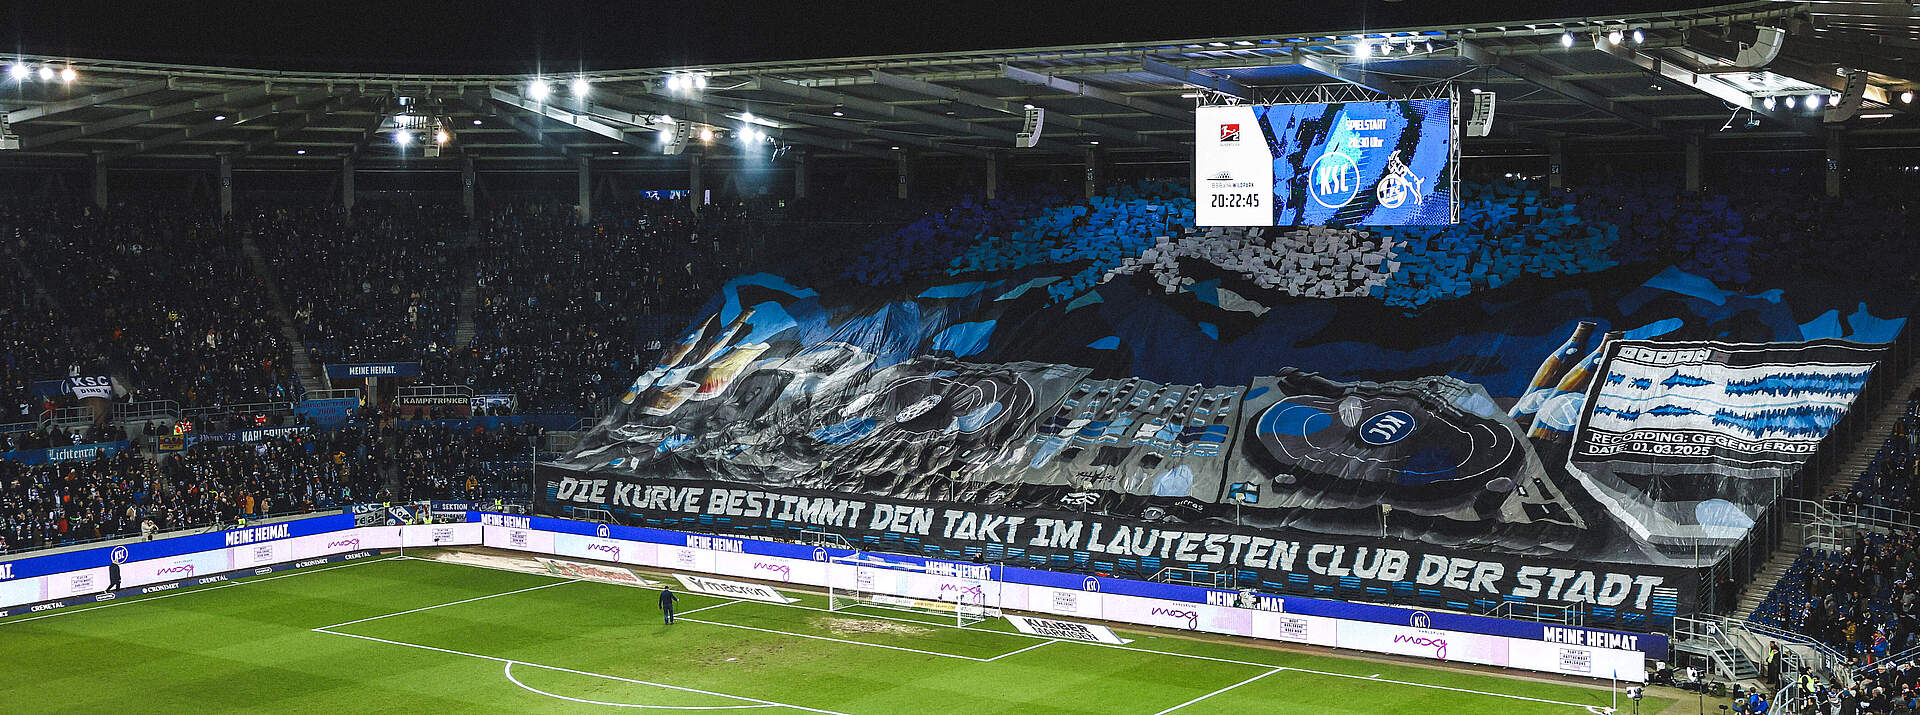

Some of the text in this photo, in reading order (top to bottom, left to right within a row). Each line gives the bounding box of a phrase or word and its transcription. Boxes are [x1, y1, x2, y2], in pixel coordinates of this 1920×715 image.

[1345, 119, 1387, 131] SPIELSTART
[1370, 137, 1385, 147] Uhr
[1320, 164, 1350, 197] KSC
[1211, 193, 1259, 208] 20:22:45
[349, 365, 396, 376] MEINE HEIMAT.
[71, 375, 109, 387] KSC
[403, 396, 468, 405] KAMPFTRINKER
[1368, 414, 1406, 440] KSC
[1588, 442, 1710, 455] DATE: 01.03.2025
[1591, 431, 1818, 453] RECORDING: GEGENGERADE
[352, 503, 381, 514] KSC
[481, 513, 504, 527] MEINE
[225, 523, 291, 547] MEINE HEIMAT.
[556, 476, 1664, 610] DIE KURVE BESTIMMT DEN TAKT IM LAUTESTEN CLUB DER STADT
[686, 534, 712, 550] MEINE
[703, 580, 770, 597] macron
[1206, 590, 1238, 608] MEIN
[1023, 617, 1091, 633] KLAIBER
[1151, 607, 1199, 630] moxy
[1031, 625, 1100, 642] MARKISEN
[1543, 626, 1640, 652] MEINE HEIMAT.
[1394, 634, 1448, 659] moxy
